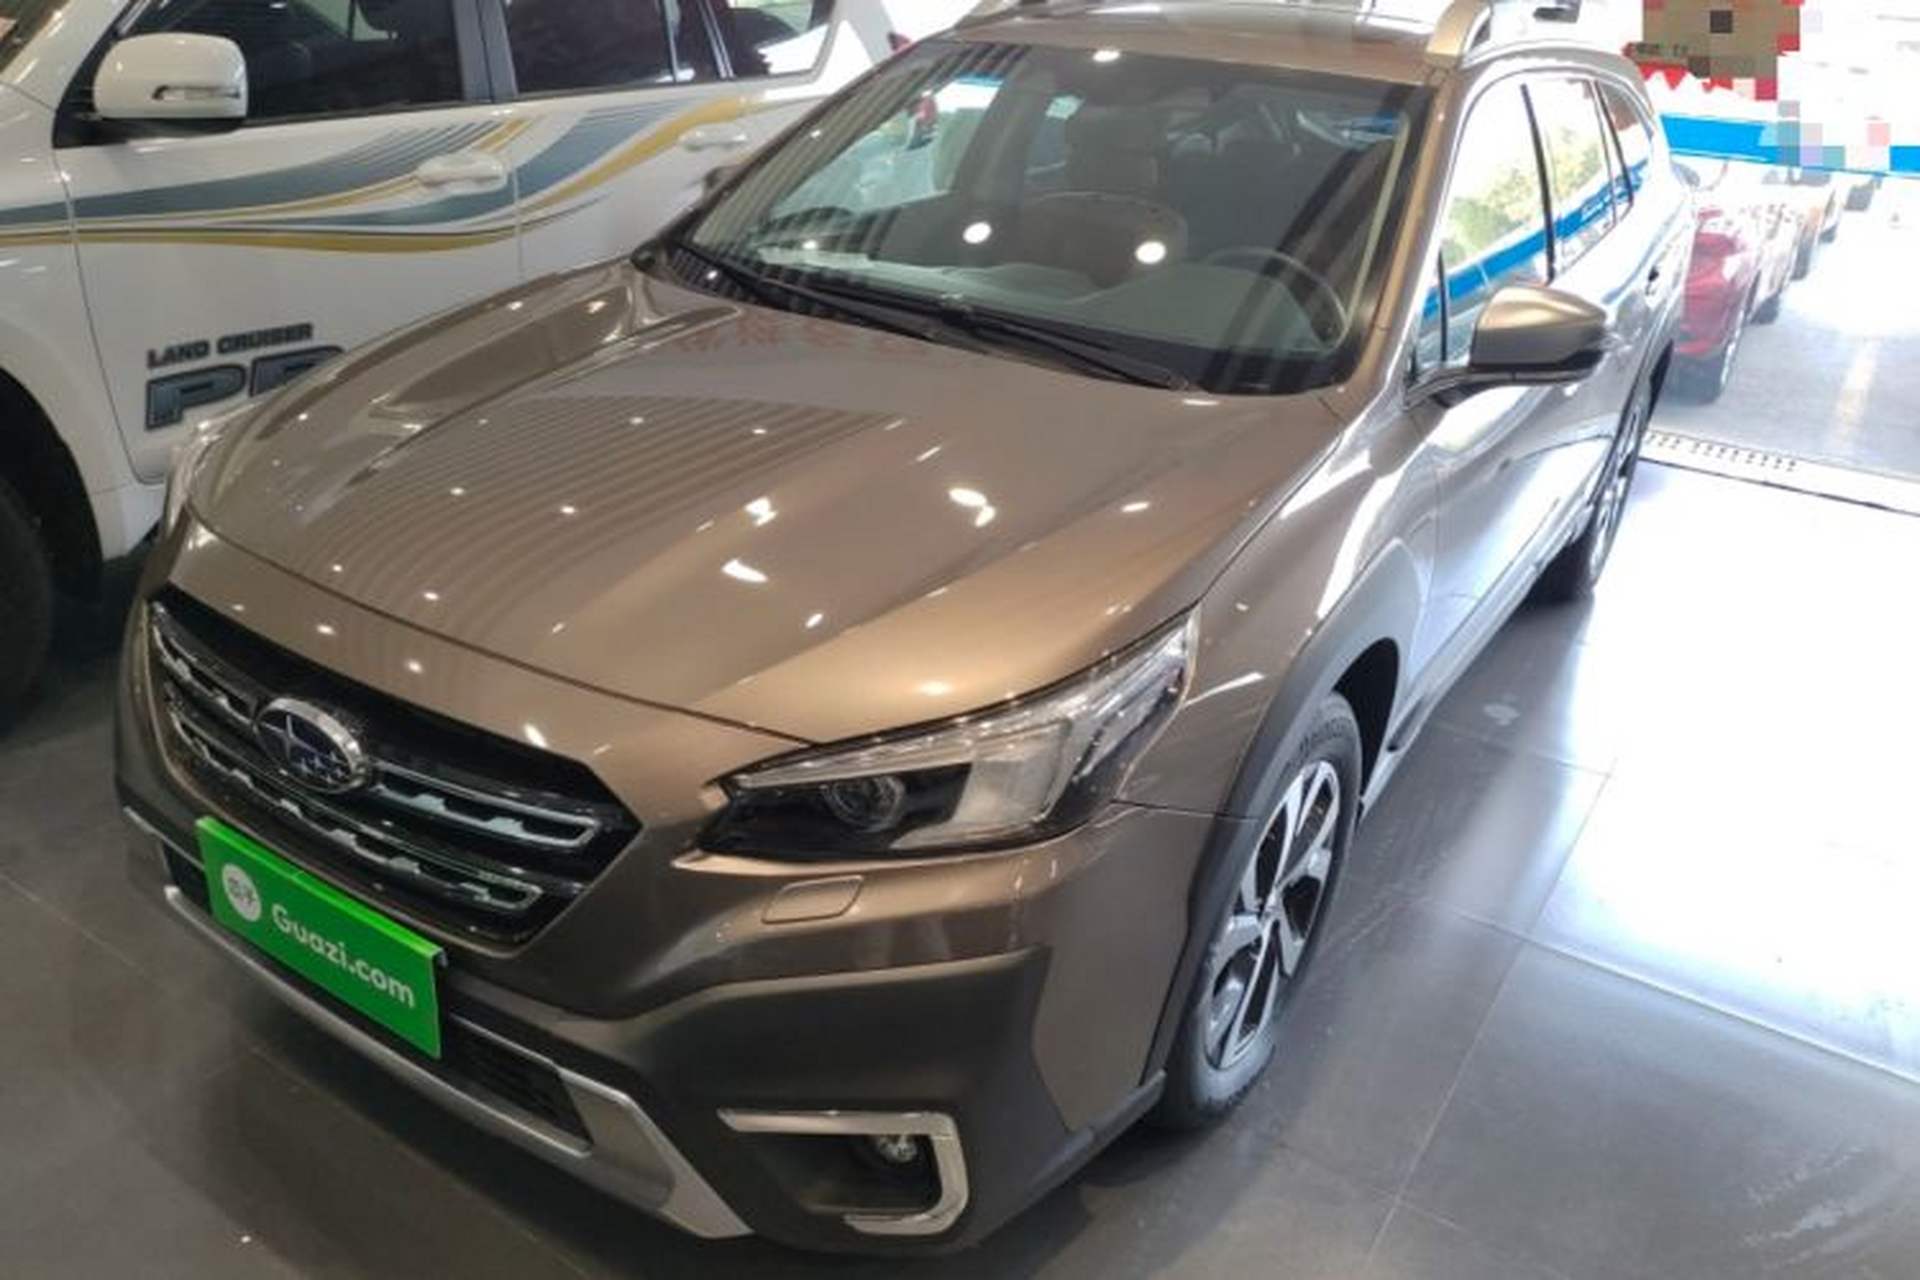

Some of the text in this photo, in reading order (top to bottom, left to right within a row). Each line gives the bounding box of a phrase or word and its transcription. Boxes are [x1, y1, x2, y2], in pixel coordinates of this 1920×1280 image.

[146, 323, 313, 368] LAND CRUISER
[272, 904, 415, 1008] Guazi.com
